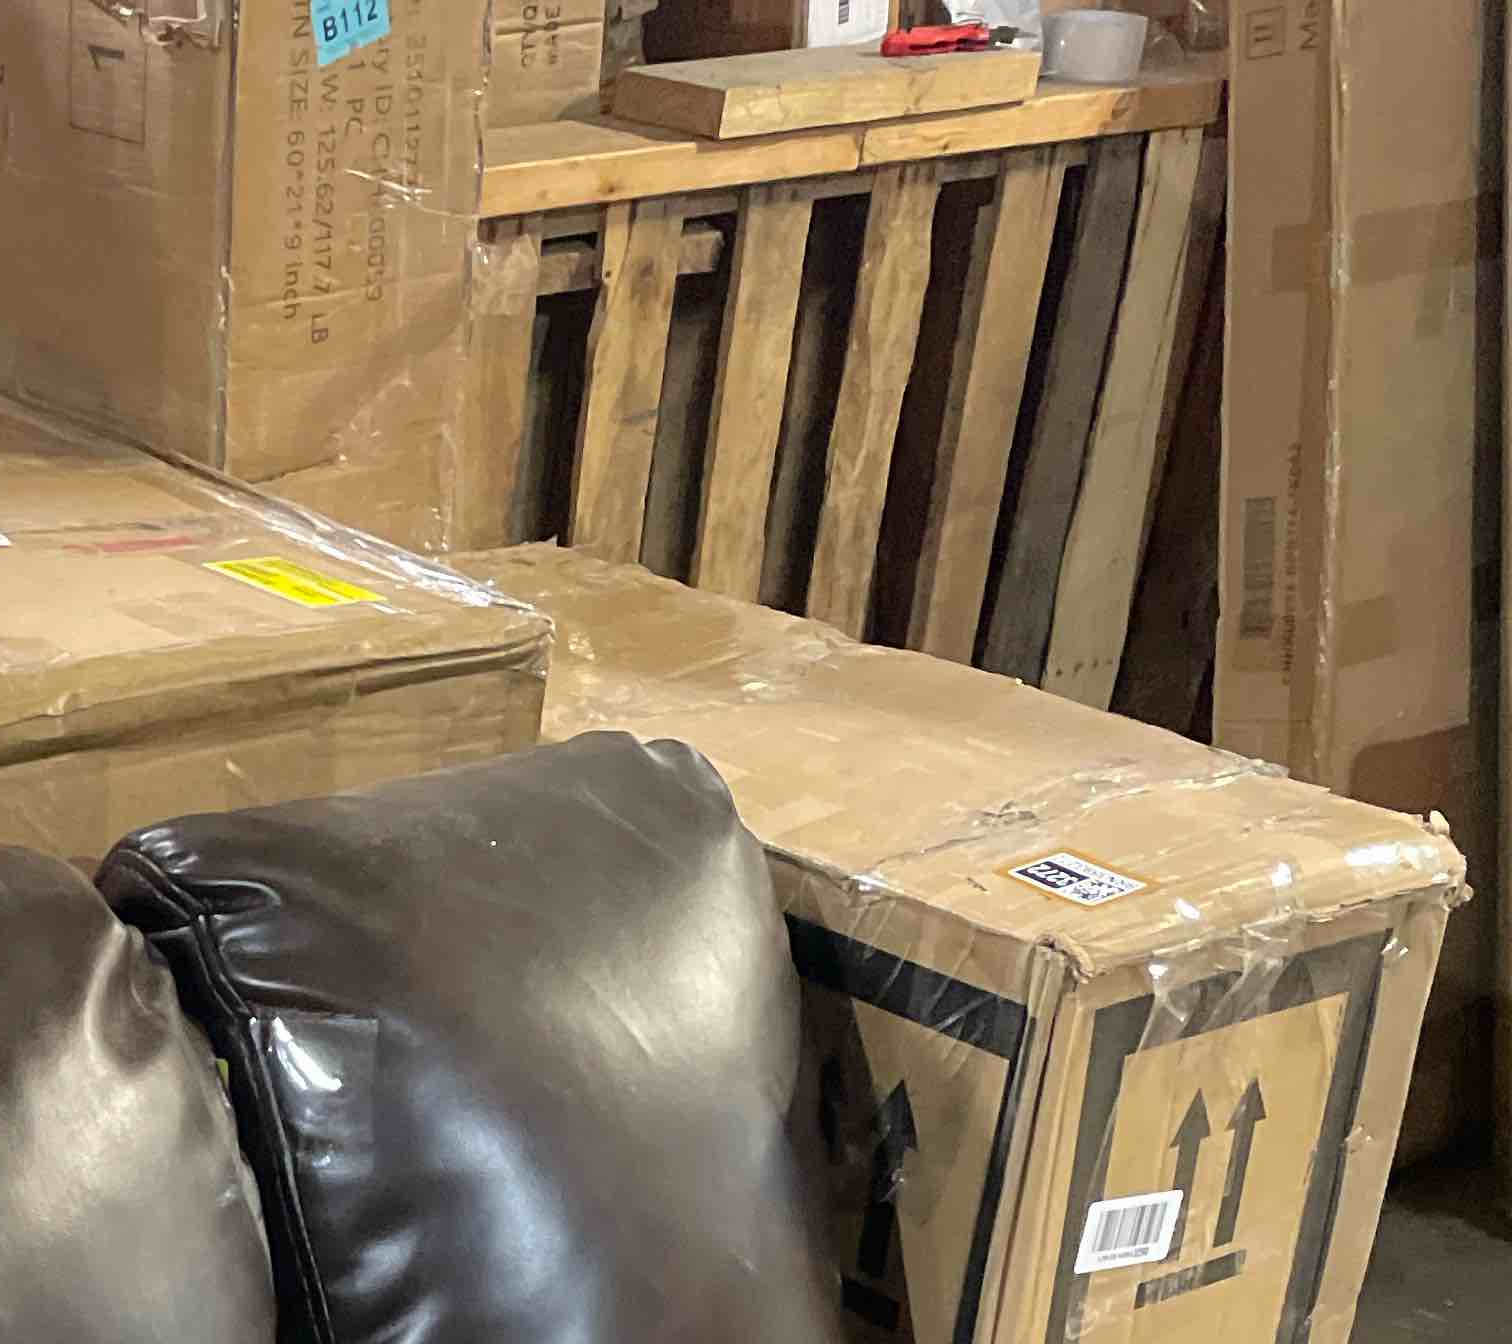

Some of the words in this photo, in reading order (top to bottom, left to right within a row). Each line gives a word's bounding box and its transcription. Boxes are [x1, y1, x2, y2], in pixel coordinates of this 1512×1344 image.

[323, 0, 378, 42] B112
[345, 98, 366, 137] PC
[282, 258, 303, 320] inch
[311, 311, 329, 344] LB
